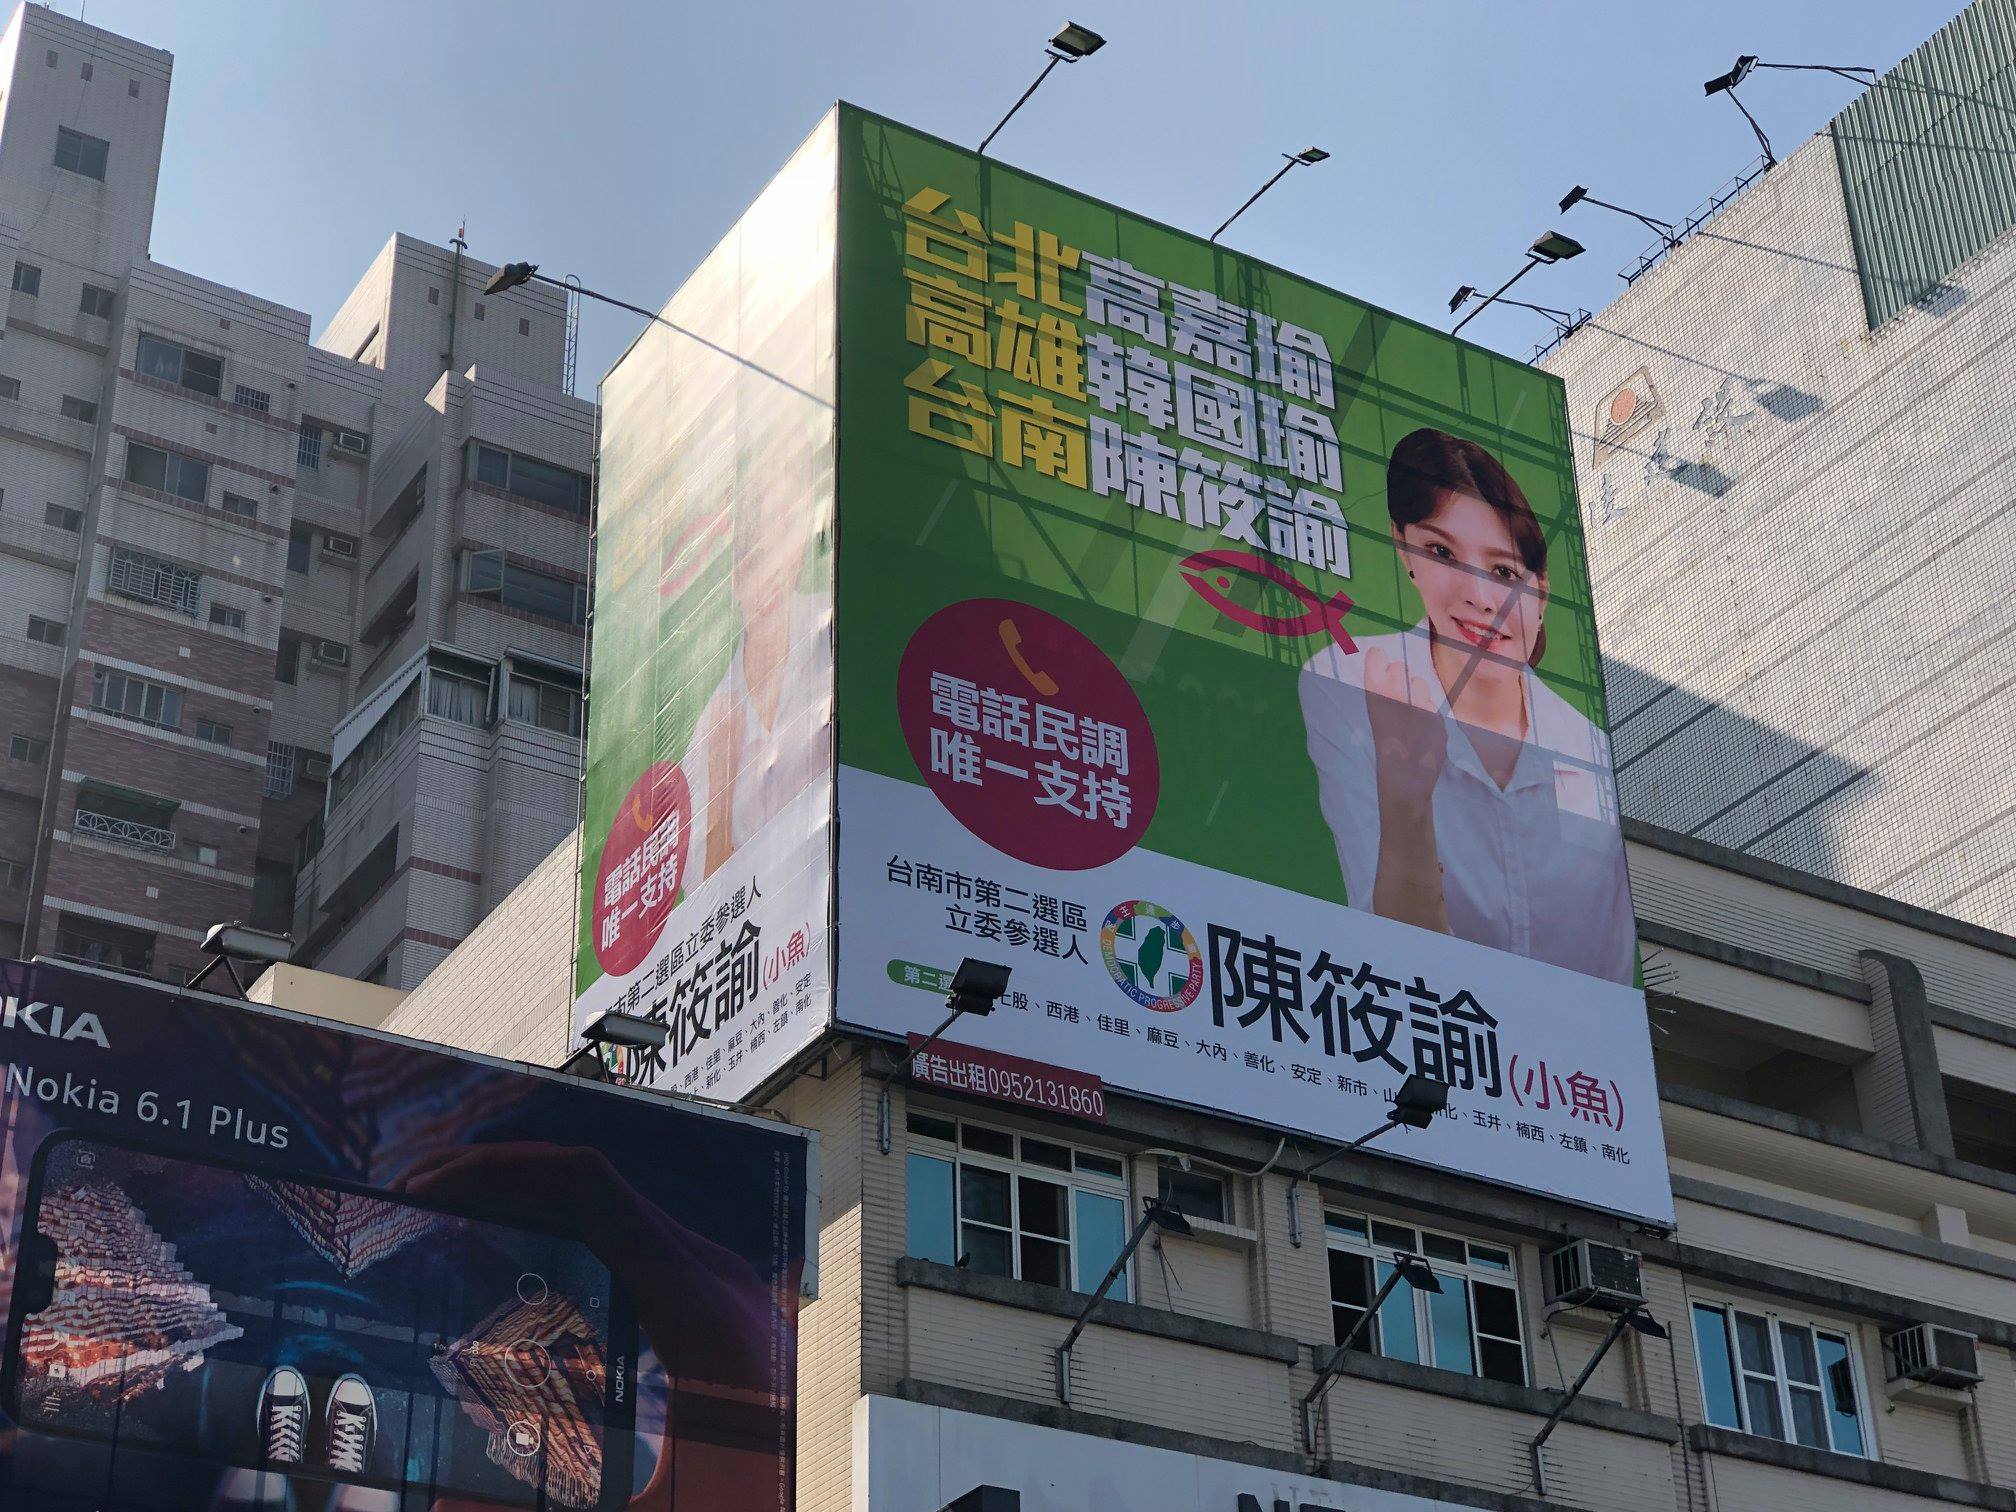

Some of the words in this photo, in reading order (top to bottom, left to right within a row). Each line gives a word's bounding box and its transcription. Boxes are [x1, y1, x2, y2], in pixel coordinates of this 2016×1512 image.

[902, 187, 1335, 410] 台北高嘉瑜
[902, 267, 1344, 493] 高雄韓國瑜
[930, 671, 1129, 776] 電話民調
[930, 727, 1132, 829] 唯一支持
[601, 853, 678, 952] 唯一支持
[886, 854, 1088, 933] 台南市第二選區
[945, 904, 1089, 965] 立委參選人
[1187, 961, 1202, 992] PARTY
[0, 996, 111, 1049] KIA
[6, 1062, 119, 1115] Nokia
[137, 1091, 191, 1129] 6.1
[209, 1105, 289, 1149] Plus
[615, 1355, 625, 1403] NOKIA
